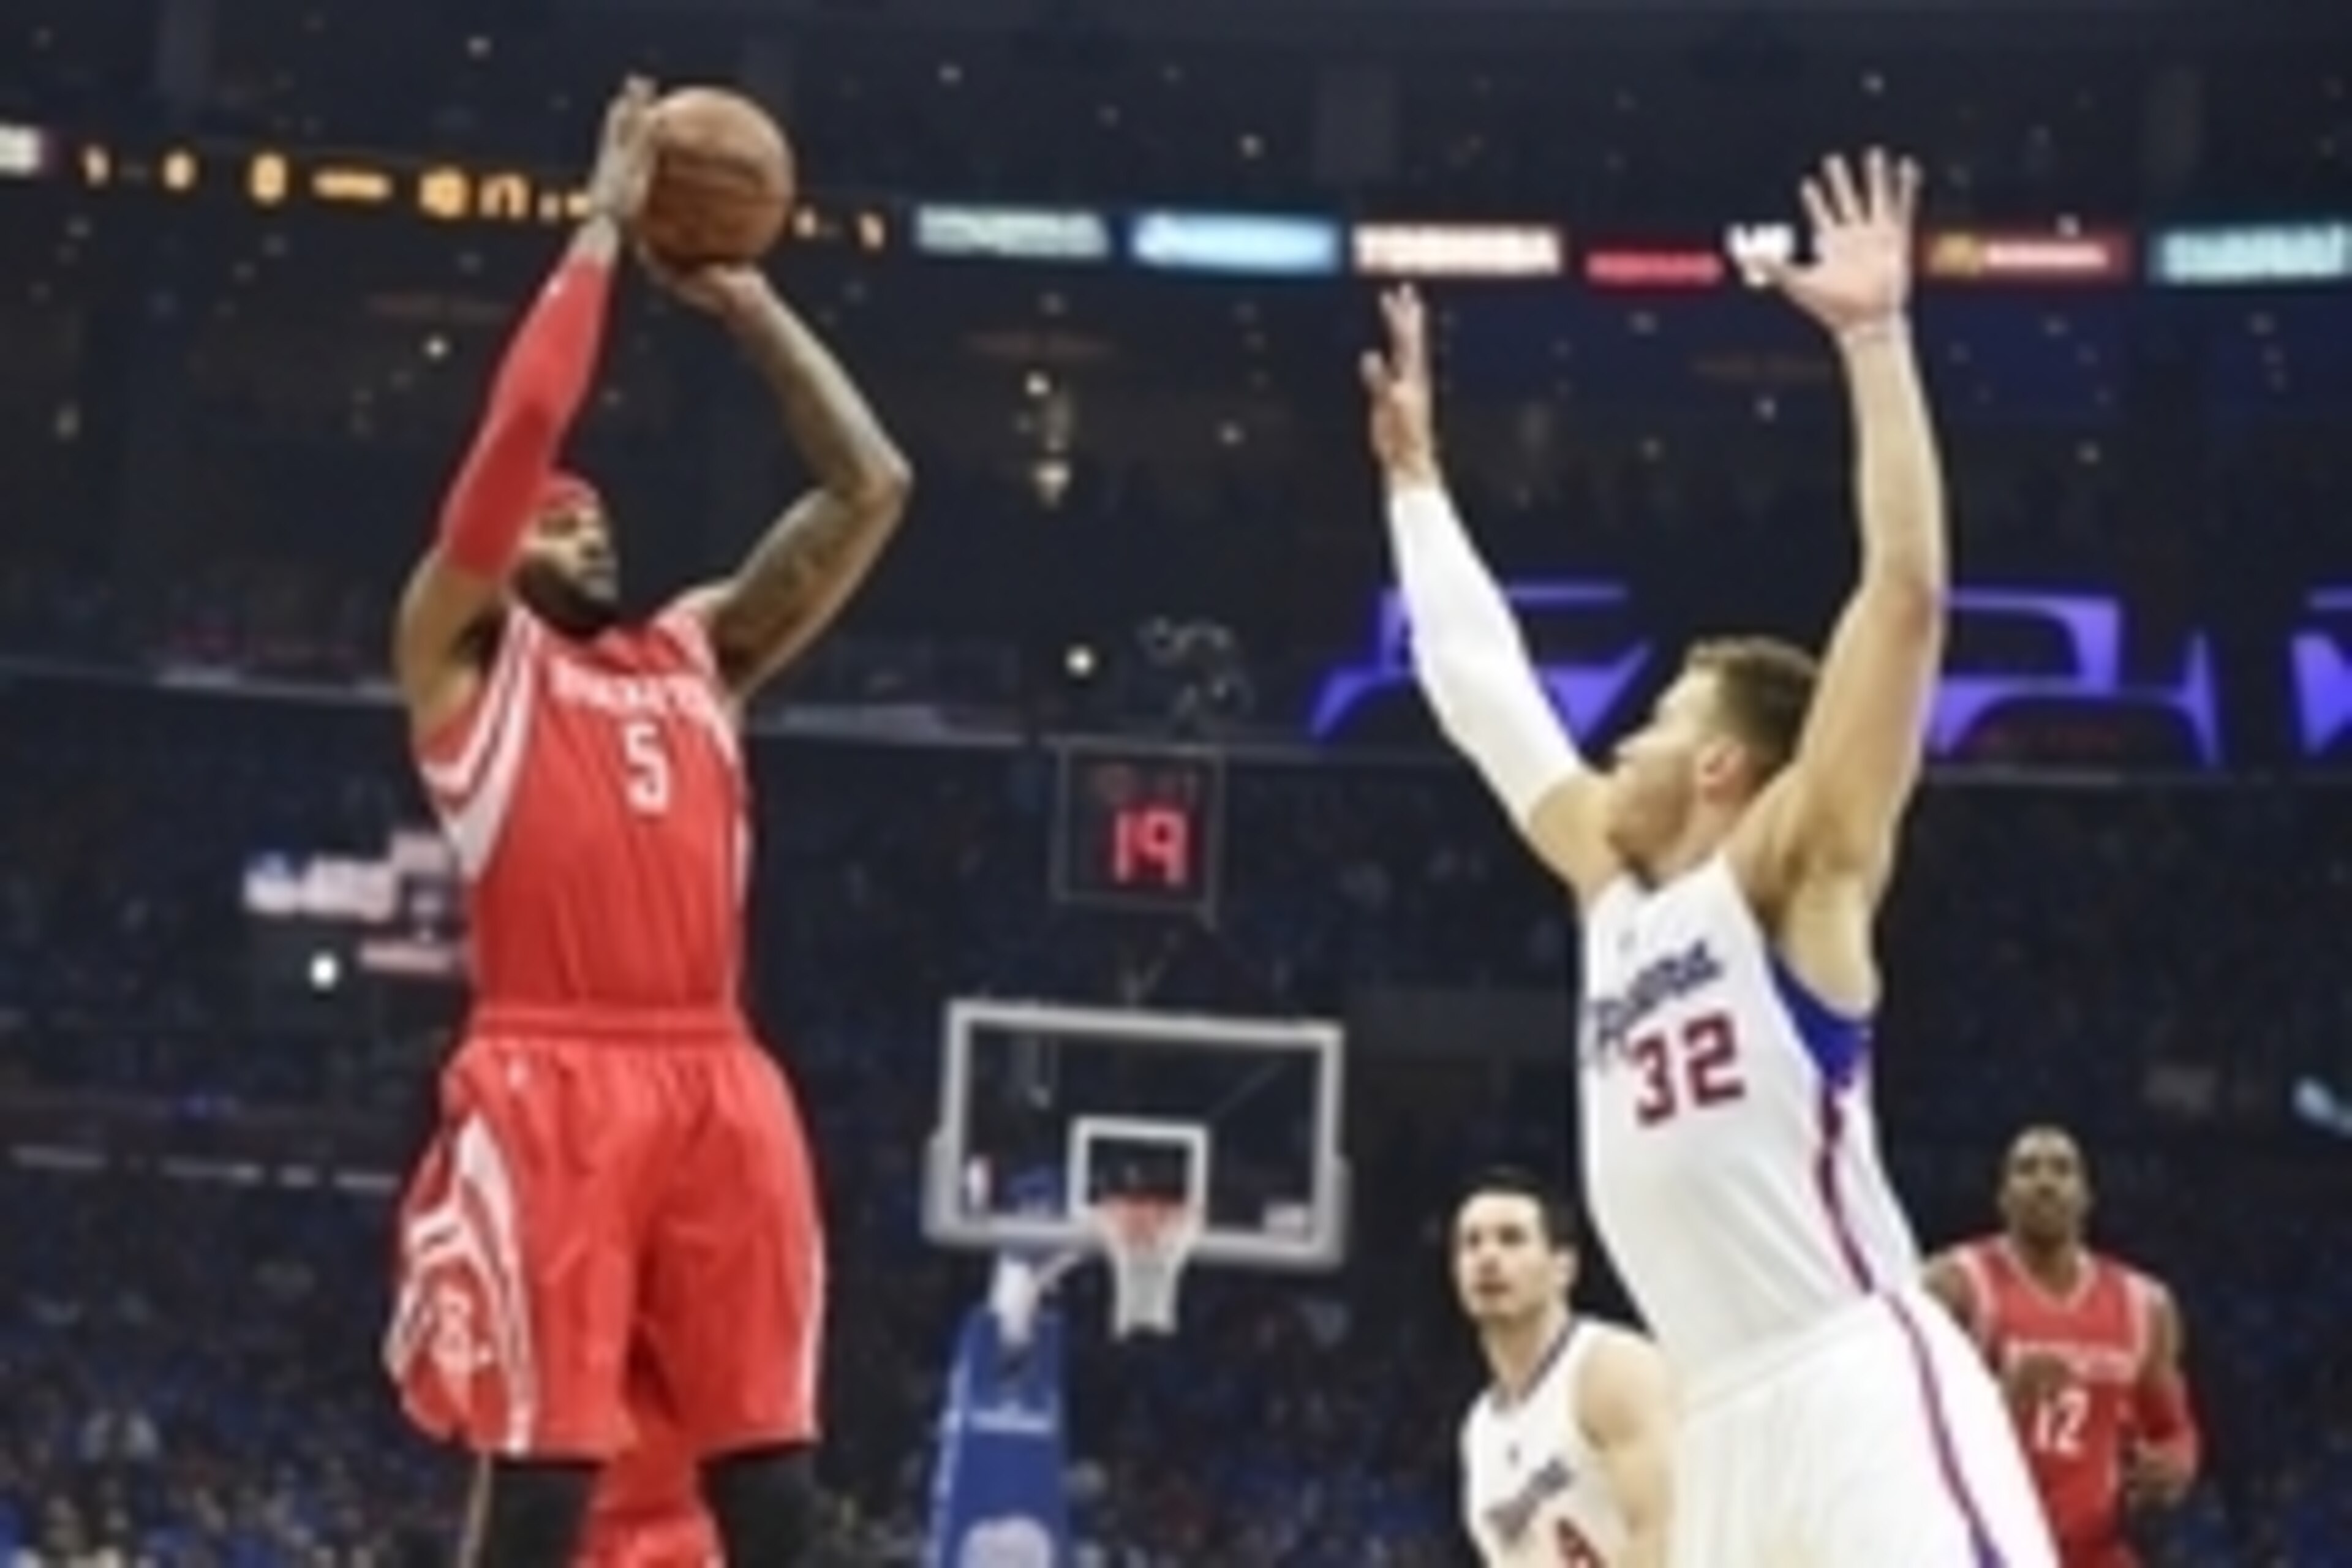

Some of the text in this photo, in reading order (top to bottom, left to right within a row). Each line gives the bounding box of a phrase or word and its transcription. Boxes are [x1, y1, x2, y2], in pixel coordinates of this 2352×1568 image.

[624, 719, 670, 816] 5
[1114, 810, 1188, 885] 19
[1629, 1012, 1747, 1128] 32
[2032, 1385, 2090, 1458] 12
